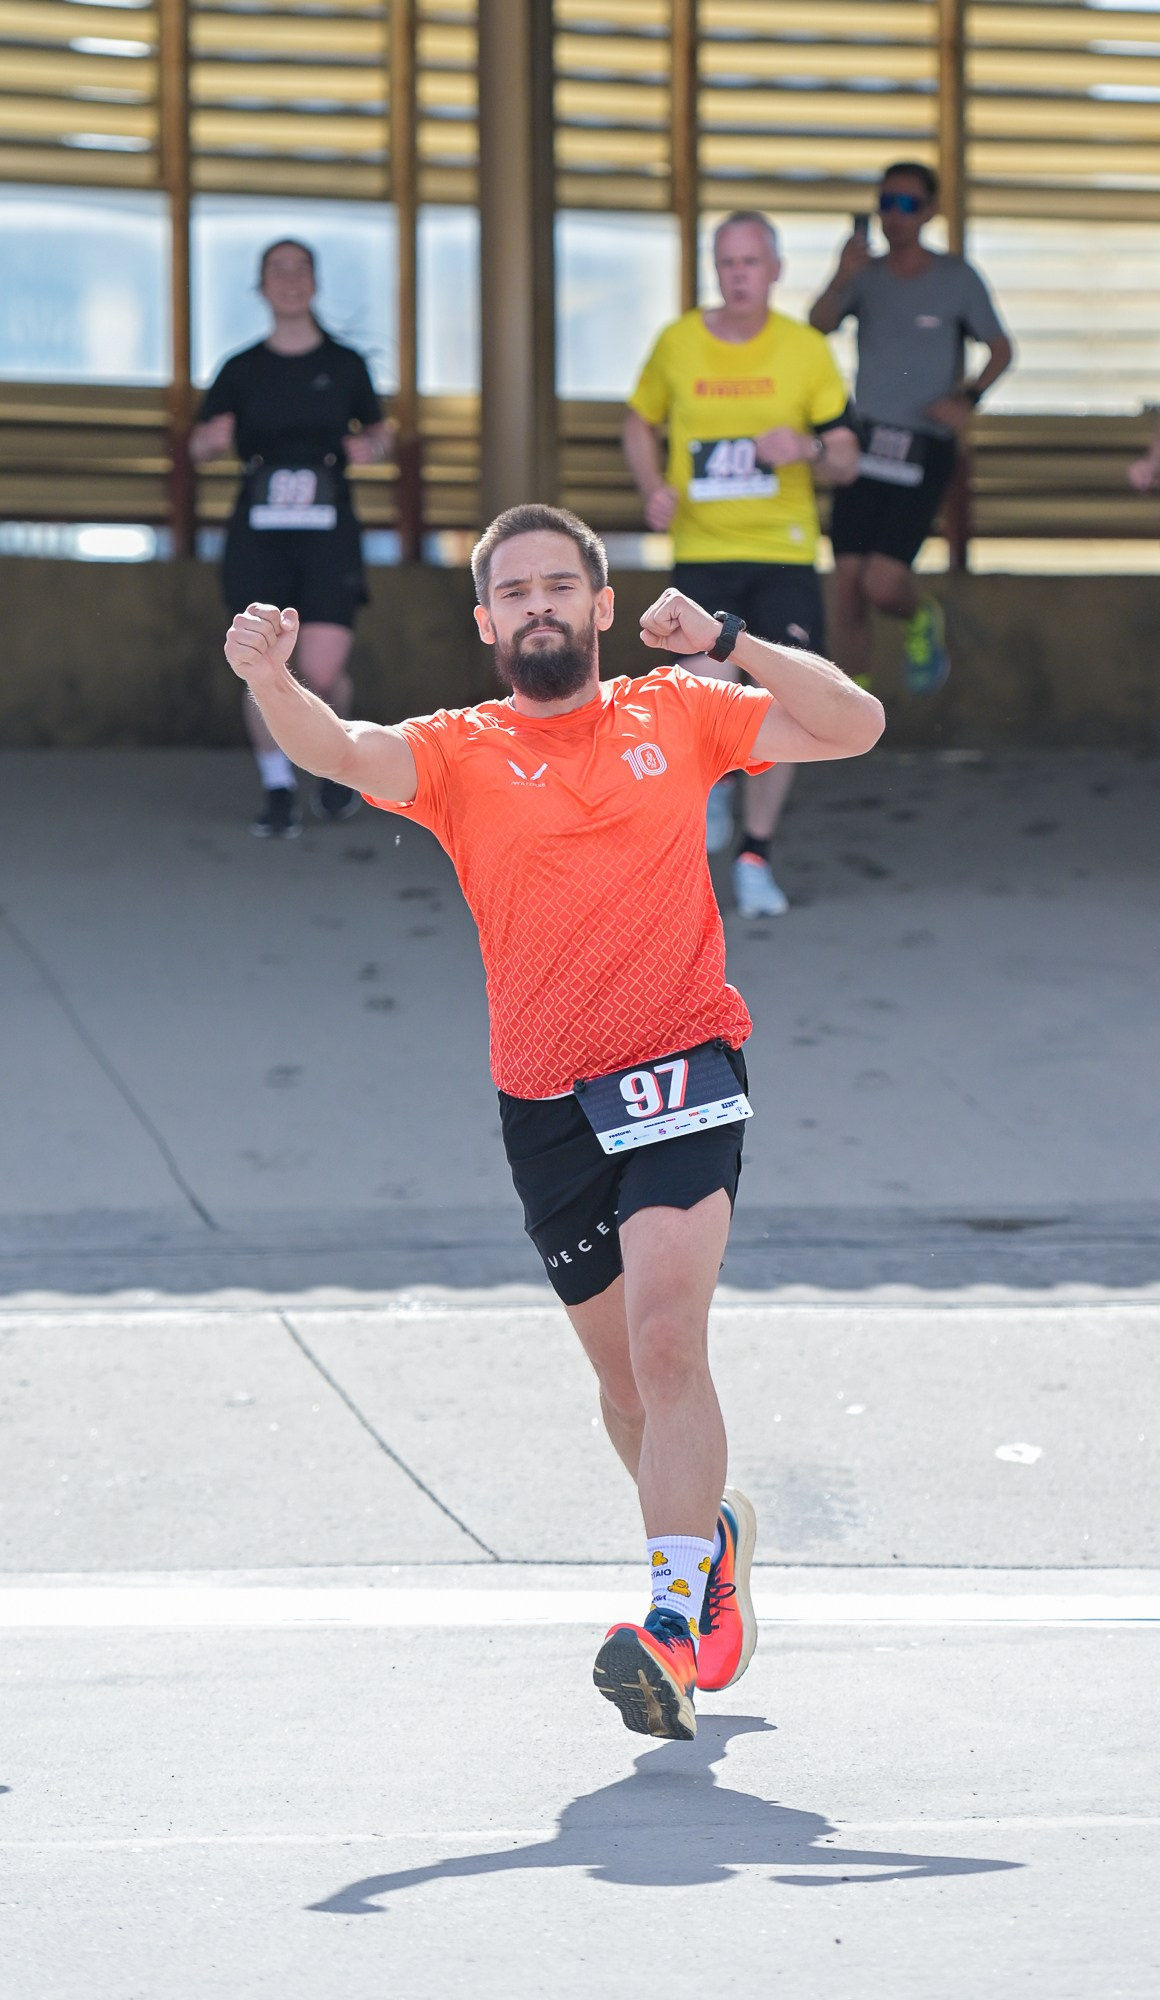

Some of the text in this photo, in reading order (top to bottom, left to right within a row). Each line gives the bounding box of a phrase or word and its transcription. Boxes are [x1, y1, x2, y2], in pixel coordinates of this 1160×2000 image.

[705, 438, 757, 476] 40
[620, 742, 668, 780] 10
[619, 1058, 689, 1118] 97
